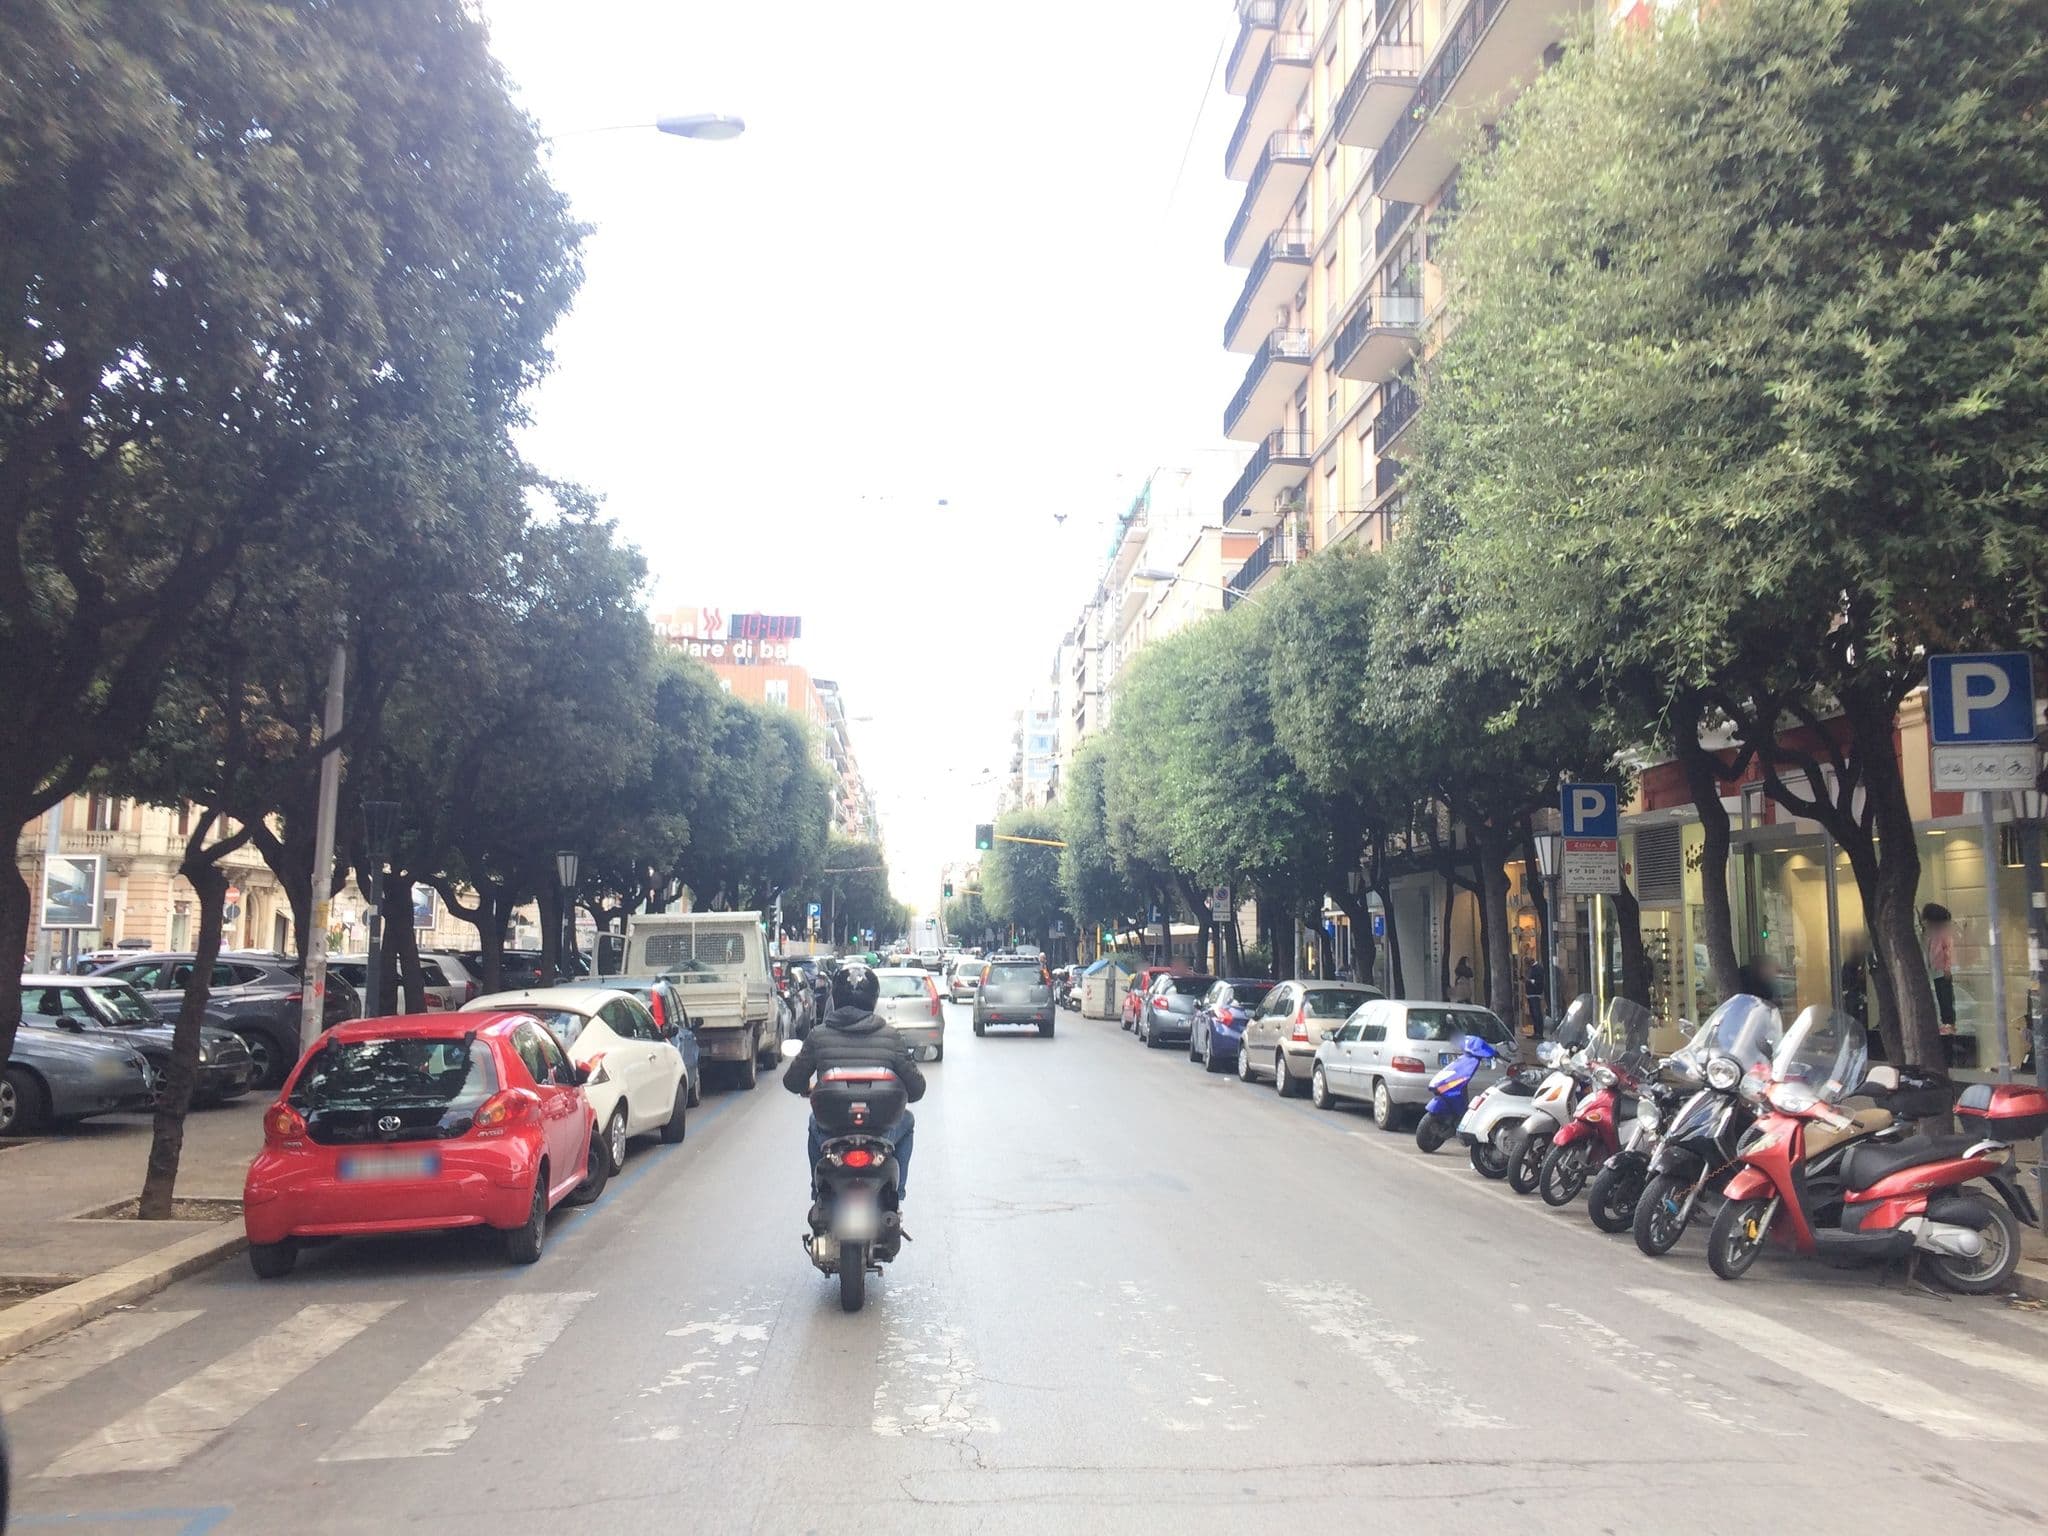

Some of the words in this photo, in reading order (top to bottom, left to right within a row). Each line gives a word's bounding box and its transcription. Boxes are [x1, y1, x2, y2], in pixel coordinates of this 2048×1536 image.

[732, 639, 753, 658] di
[1950, 662, 2010, 734] P
[1572, 788, 1607, 833] P
[1600, 840, 1609, 848] A
[809, 904, 819, 916] P
